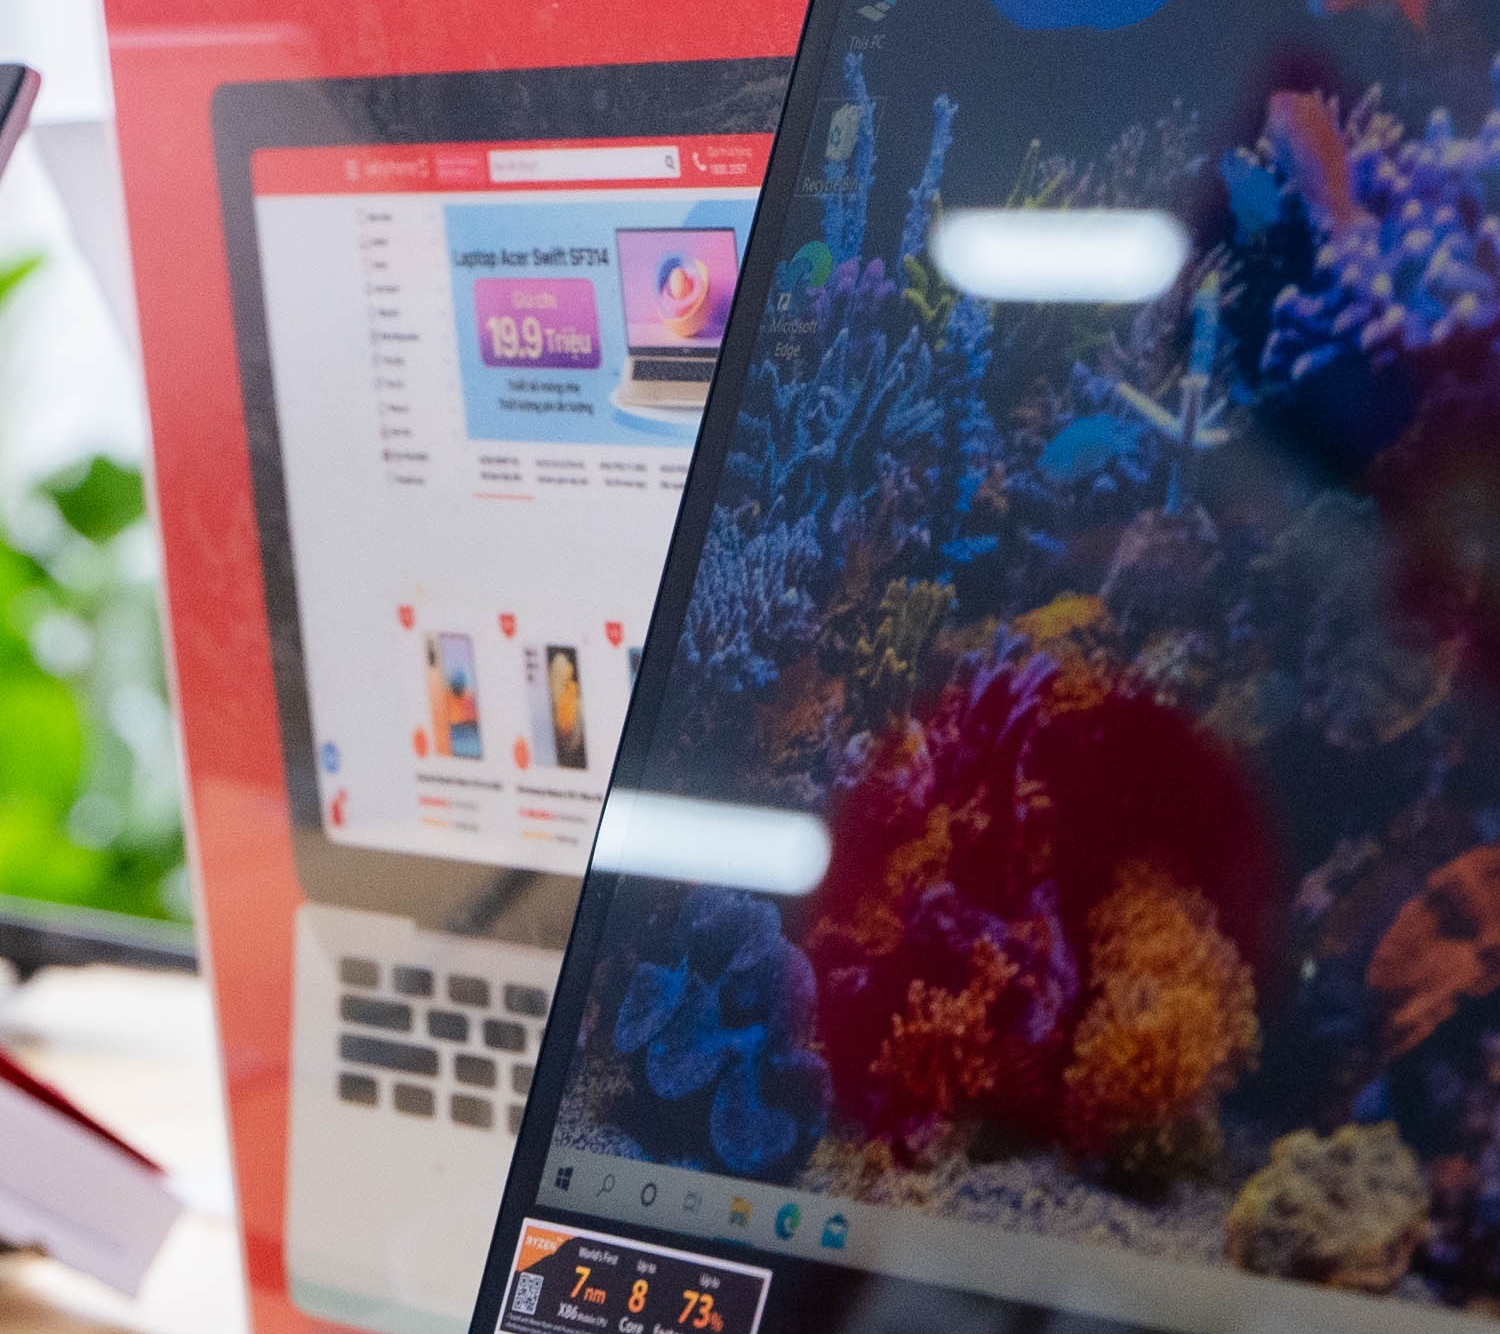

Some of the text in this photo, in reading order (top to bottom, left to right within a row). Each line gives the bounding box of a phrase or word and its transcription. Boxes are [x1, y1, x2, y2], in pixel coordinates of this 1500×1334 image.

[455, 249, 496, 269] Laptop
[502, 248, 528, 266] Acer
[533, 247, 567, 266] Swift
[487, 316, 543, 359] 19.9
[770, 319, 818, 334] Microsoft
[775, 344, 801, 360] Edge
[628, 1278, 649, 1314] 8
